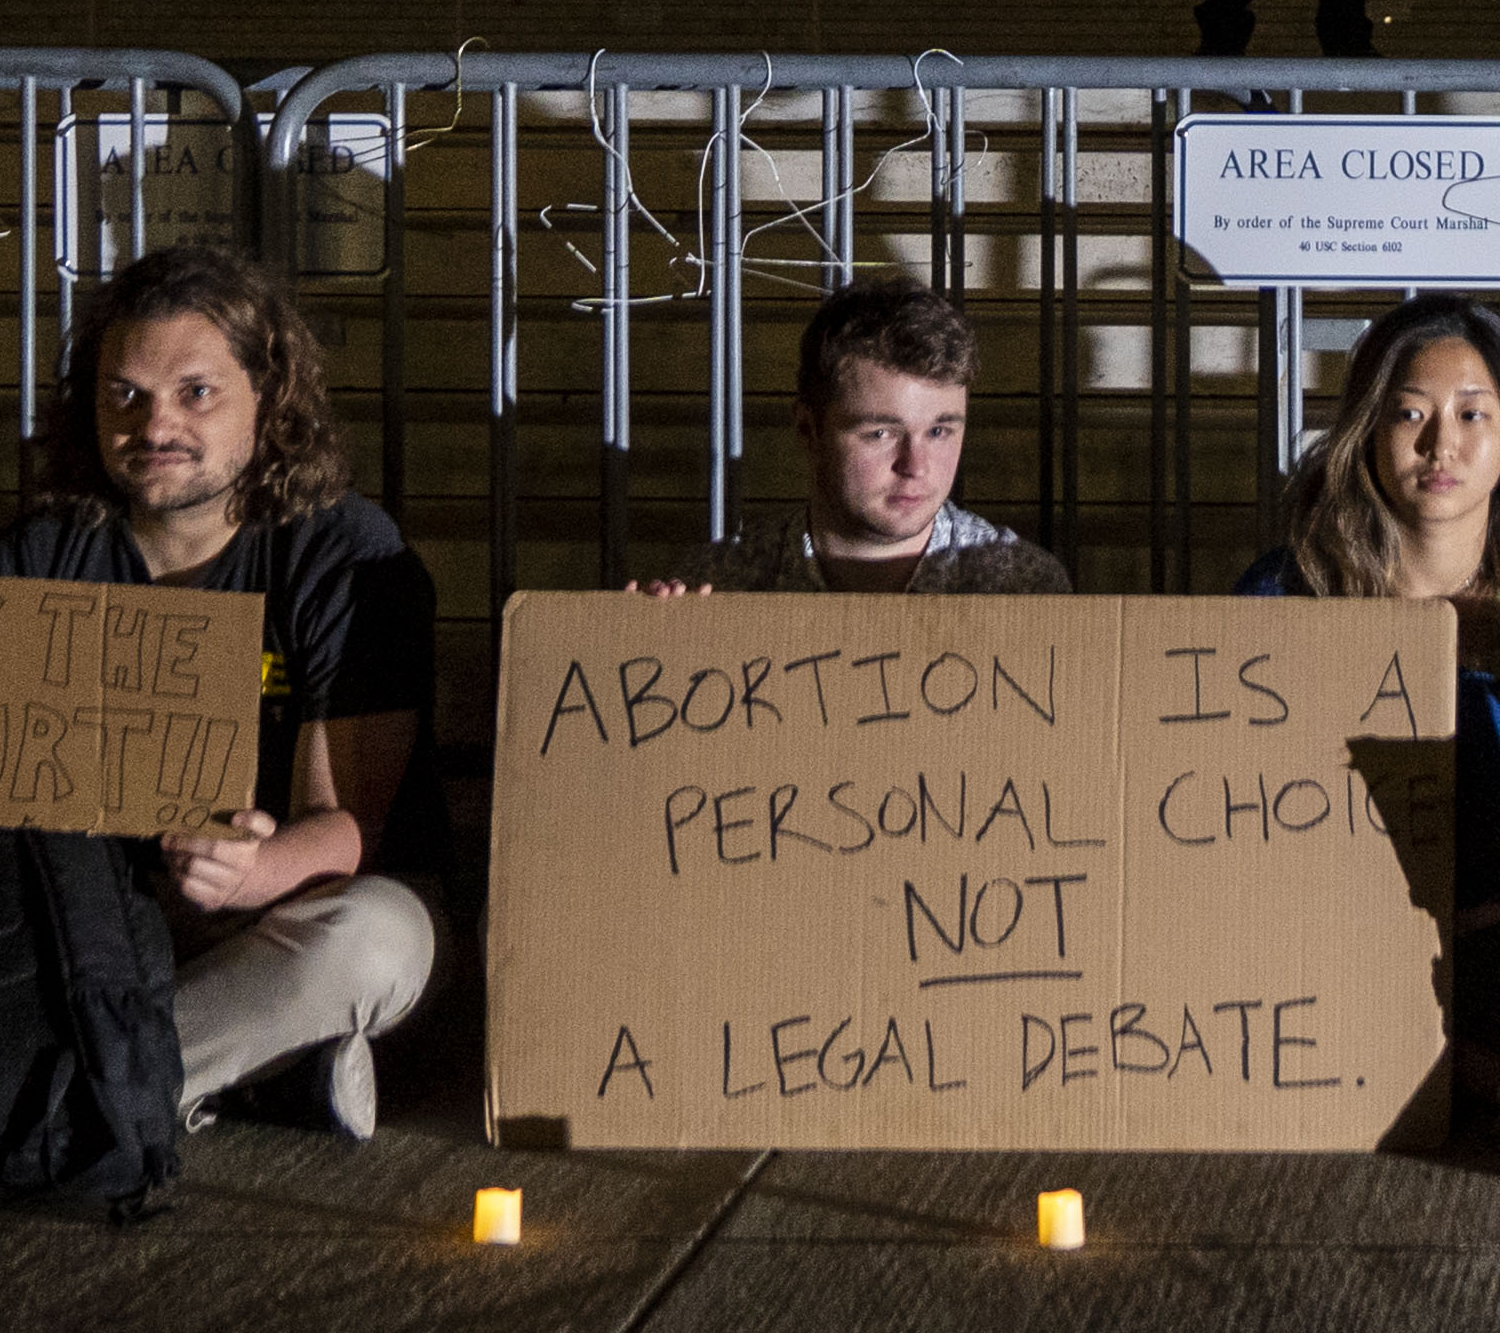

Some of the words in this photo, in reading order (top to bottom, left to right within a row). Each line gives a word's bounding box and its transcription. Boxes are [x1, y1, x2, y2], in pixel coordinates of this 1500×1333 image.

[1220, 149, 1323, 179] AREA
[1341, 149, 1485, 181] CLOSED
[1214, 215, 1231, 230] By
[1237, 215, 1272, 229] order
[1279, 215, 1294, 229] of
[1301, 215, 1321, 229] the
[1327, 215, 1385, 232] Supreme
[1390, 216, 1428, 230] Court
[1435, 217, 1489, 231] Marshal
[1298, 241, 1311, 252] 40
[1316, 241, 1337, 252] USC
[1341, 241, 1377, 252] Section
[1382, 241, 1402, 252] 6102
[37, 592, 212, 700] THE
[540, 644, 1057, 756] ABORTION
[1159, 647, 1291, 727] IS
[1359, 651, 1418, 739] A
[662, 770, 1106, 874] PERSONAL
[1158, 770, 1443, 848] CHOICE
[903, 871, 1088, 962] NOT
[598, 1024, 653, 1099] A
[721, 1013, 968, 1098] LEGAL
[1021, 997, 1367, 1090] DEBATE.
